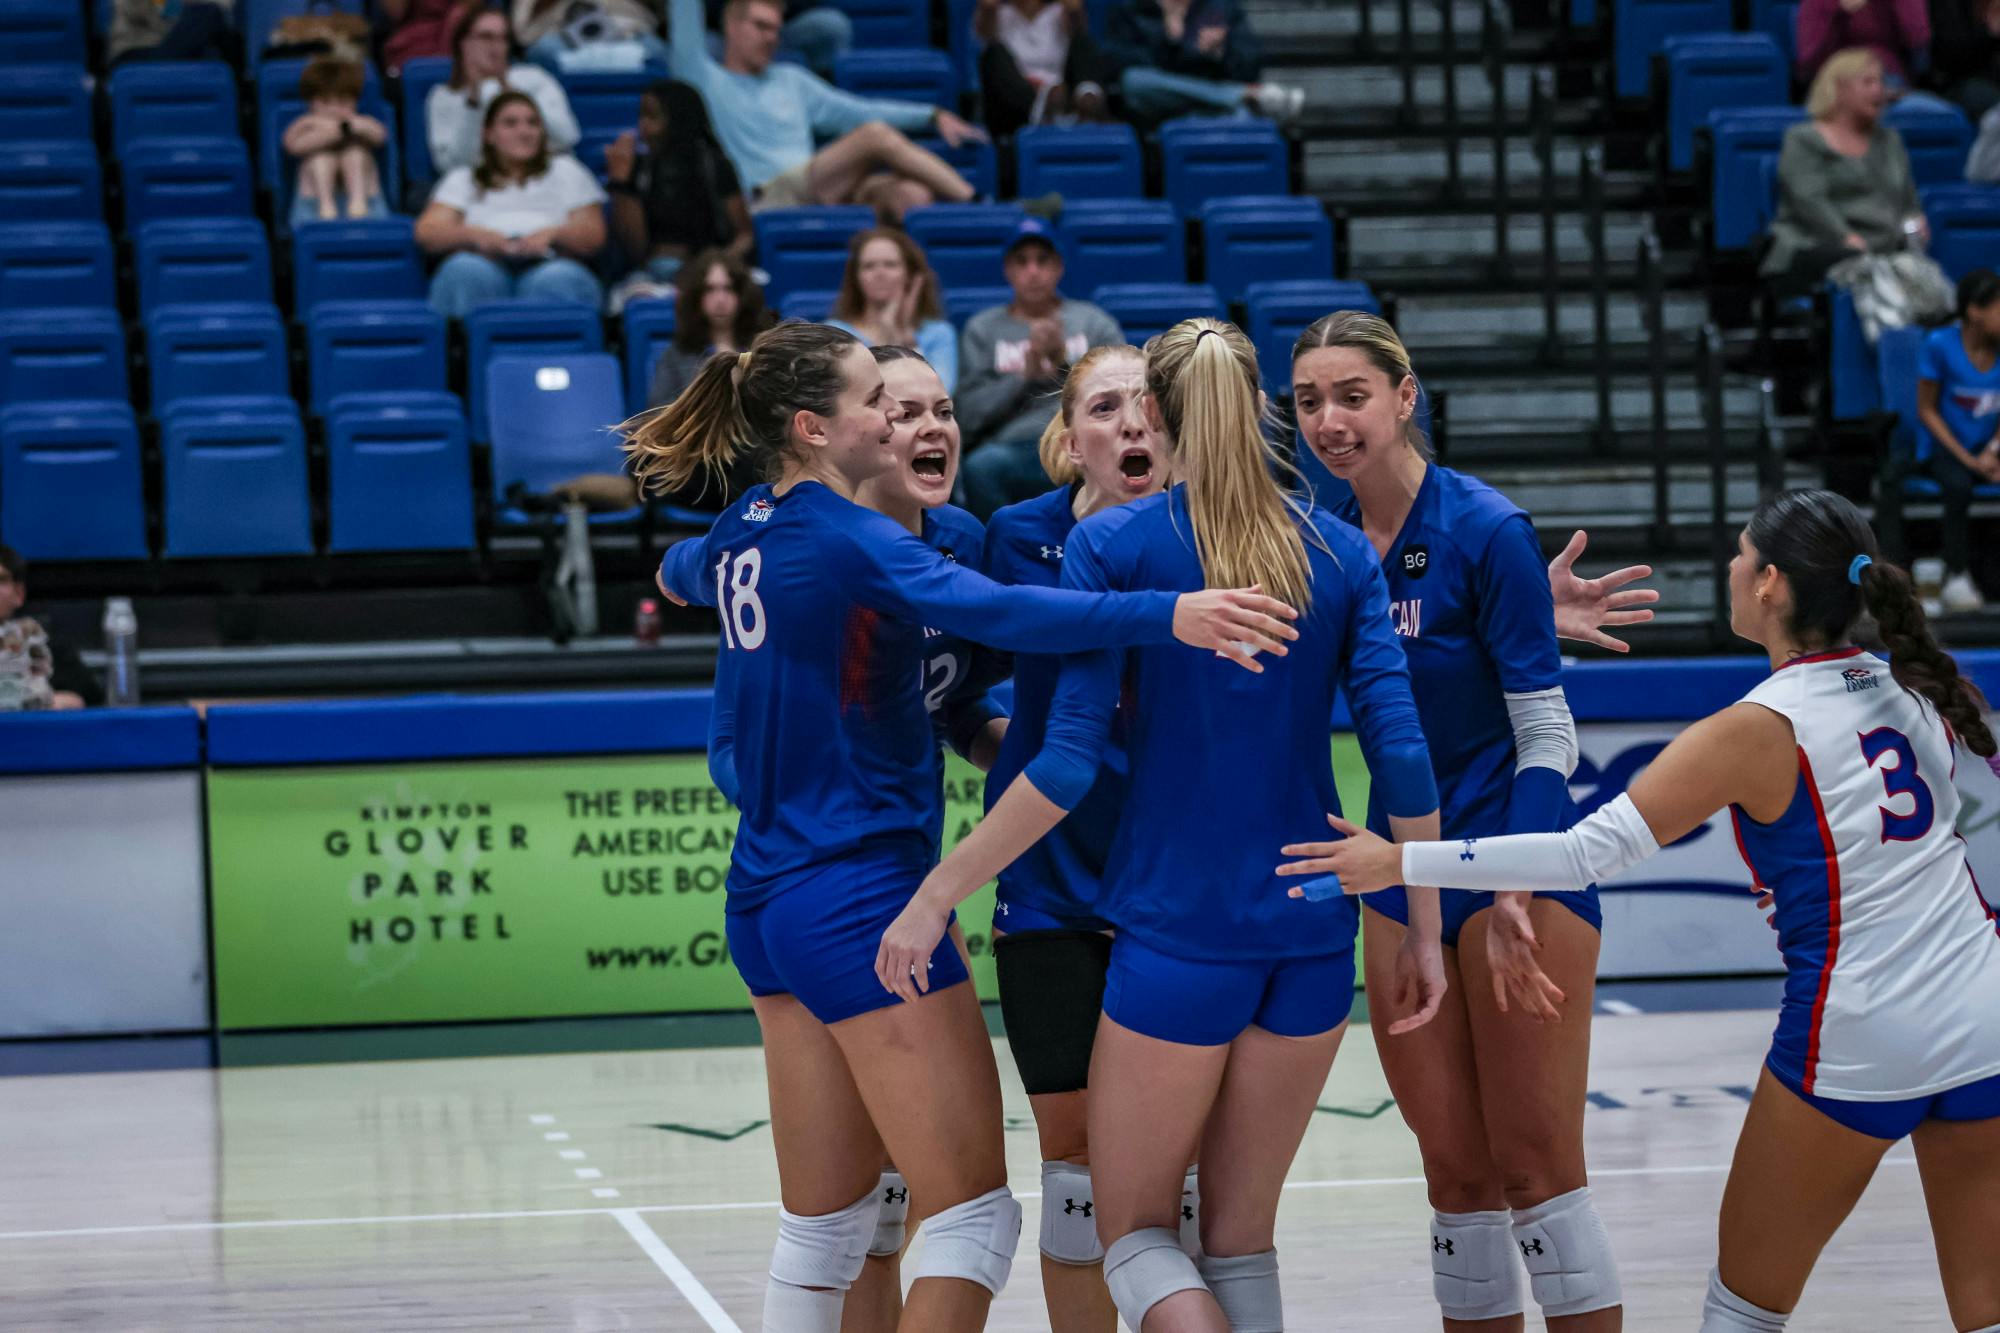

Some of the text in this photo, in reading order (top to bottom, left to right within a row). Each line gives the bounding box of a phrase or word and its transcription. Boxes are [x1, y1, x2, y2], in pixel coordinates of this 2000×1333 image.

[1405, 552, 1427, 569] BG
[716, 548, 766, 649] 18
[1857, 726, 1934, 845] 3
[361, 804, 491, 821] KIMPTON
[564, 790, 623, 818] THE
[634, 787, 738, 816] PREFE
[325, 825, 527, 857] GLOVER
[363, 869, 491, 898] PARK
[603, 865, 729, 896] USE BO
[351, 914, 510, 943] HOTEL
